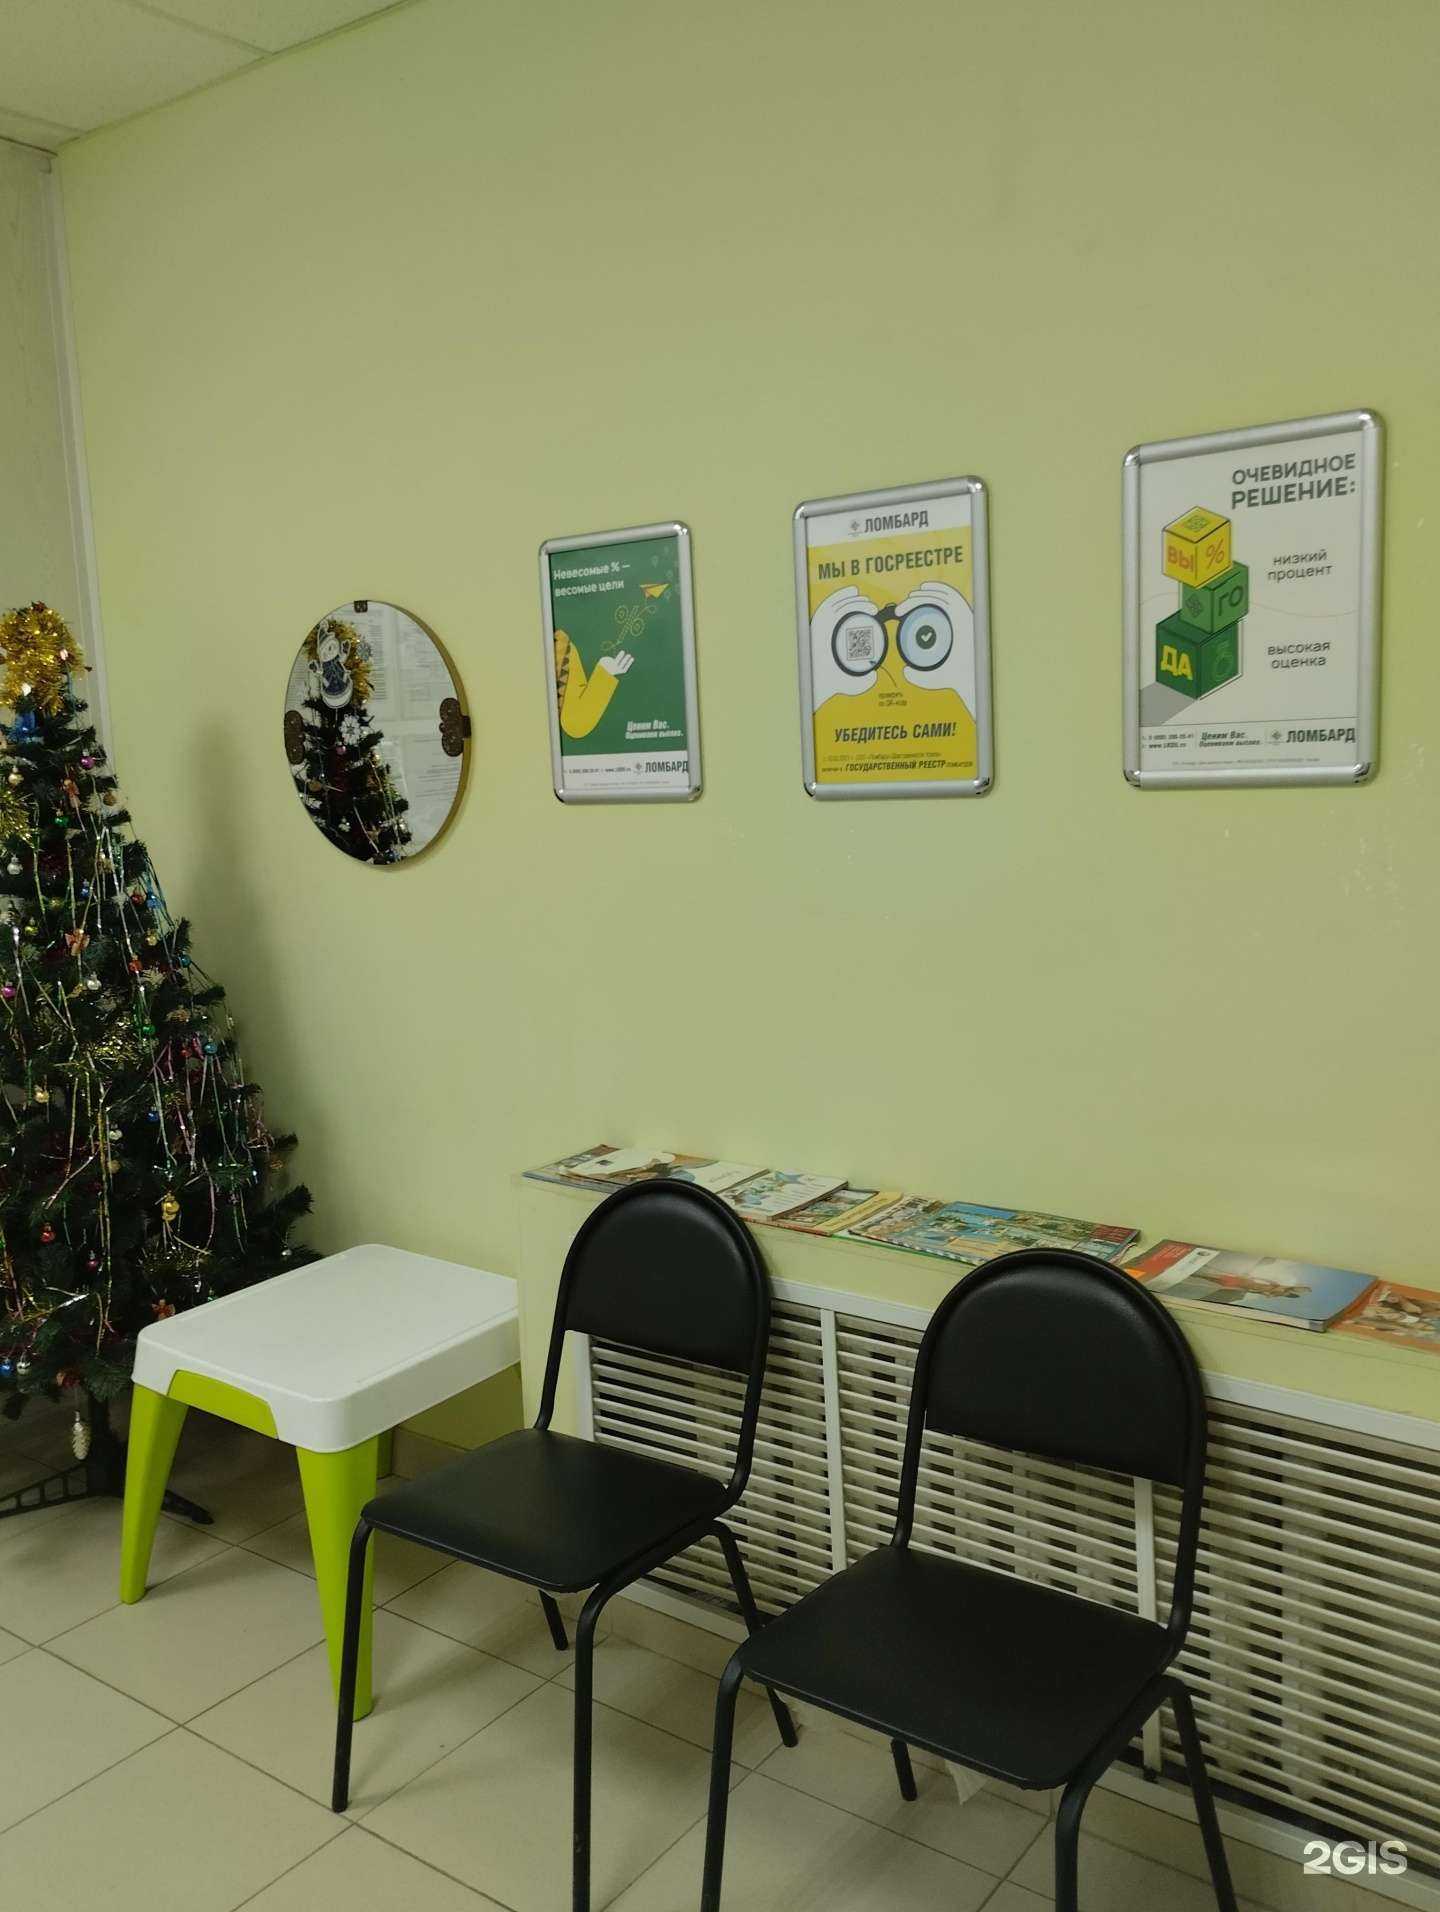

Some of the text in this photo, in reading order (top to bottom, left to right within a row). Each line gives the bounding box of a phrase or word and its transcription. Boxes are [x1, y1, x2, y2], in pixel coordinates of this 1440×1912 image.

[1232, 452, 1356, 485] ОЧЕВИДНОЕ
[1231, 476, 1356, 510] РЕШЕНИЕ:
[864, 510, 929, 533] ЛОМБАРД
[818, 545, 963, 580] МЫ В ГОСРЕЕСТРЕ
[1166, 545, 1194, 573] ВЫ
[1205, 539, 1225, 569] %
[1272, 549, 1328, 566] низкий
[553, 564, 610, 580] Невесомые
[611, 561, 619, 572] %
[1267, 564, 1333, 583] процент
[555, 580, 624, 597] весомые цели
[1217, 585, 1244, 617] ГО
[1267, 641, 1331, 656] высокая
[1160, 645, 1194, 681] ДА
[1271, 656, 1327, 670] оценка
[834, 722, 957, 743] УБЕДИТЕСЬ САМИ!
[1286, 728, 1356, 743] ЛОМБАРД
[645, 760, 688, 773] ЛОМБАРД
[845, 760, 917, 773] ГОСУДАРСТВЕННЫЙ
[918, 760, 946, 769] РЕЕСТР
